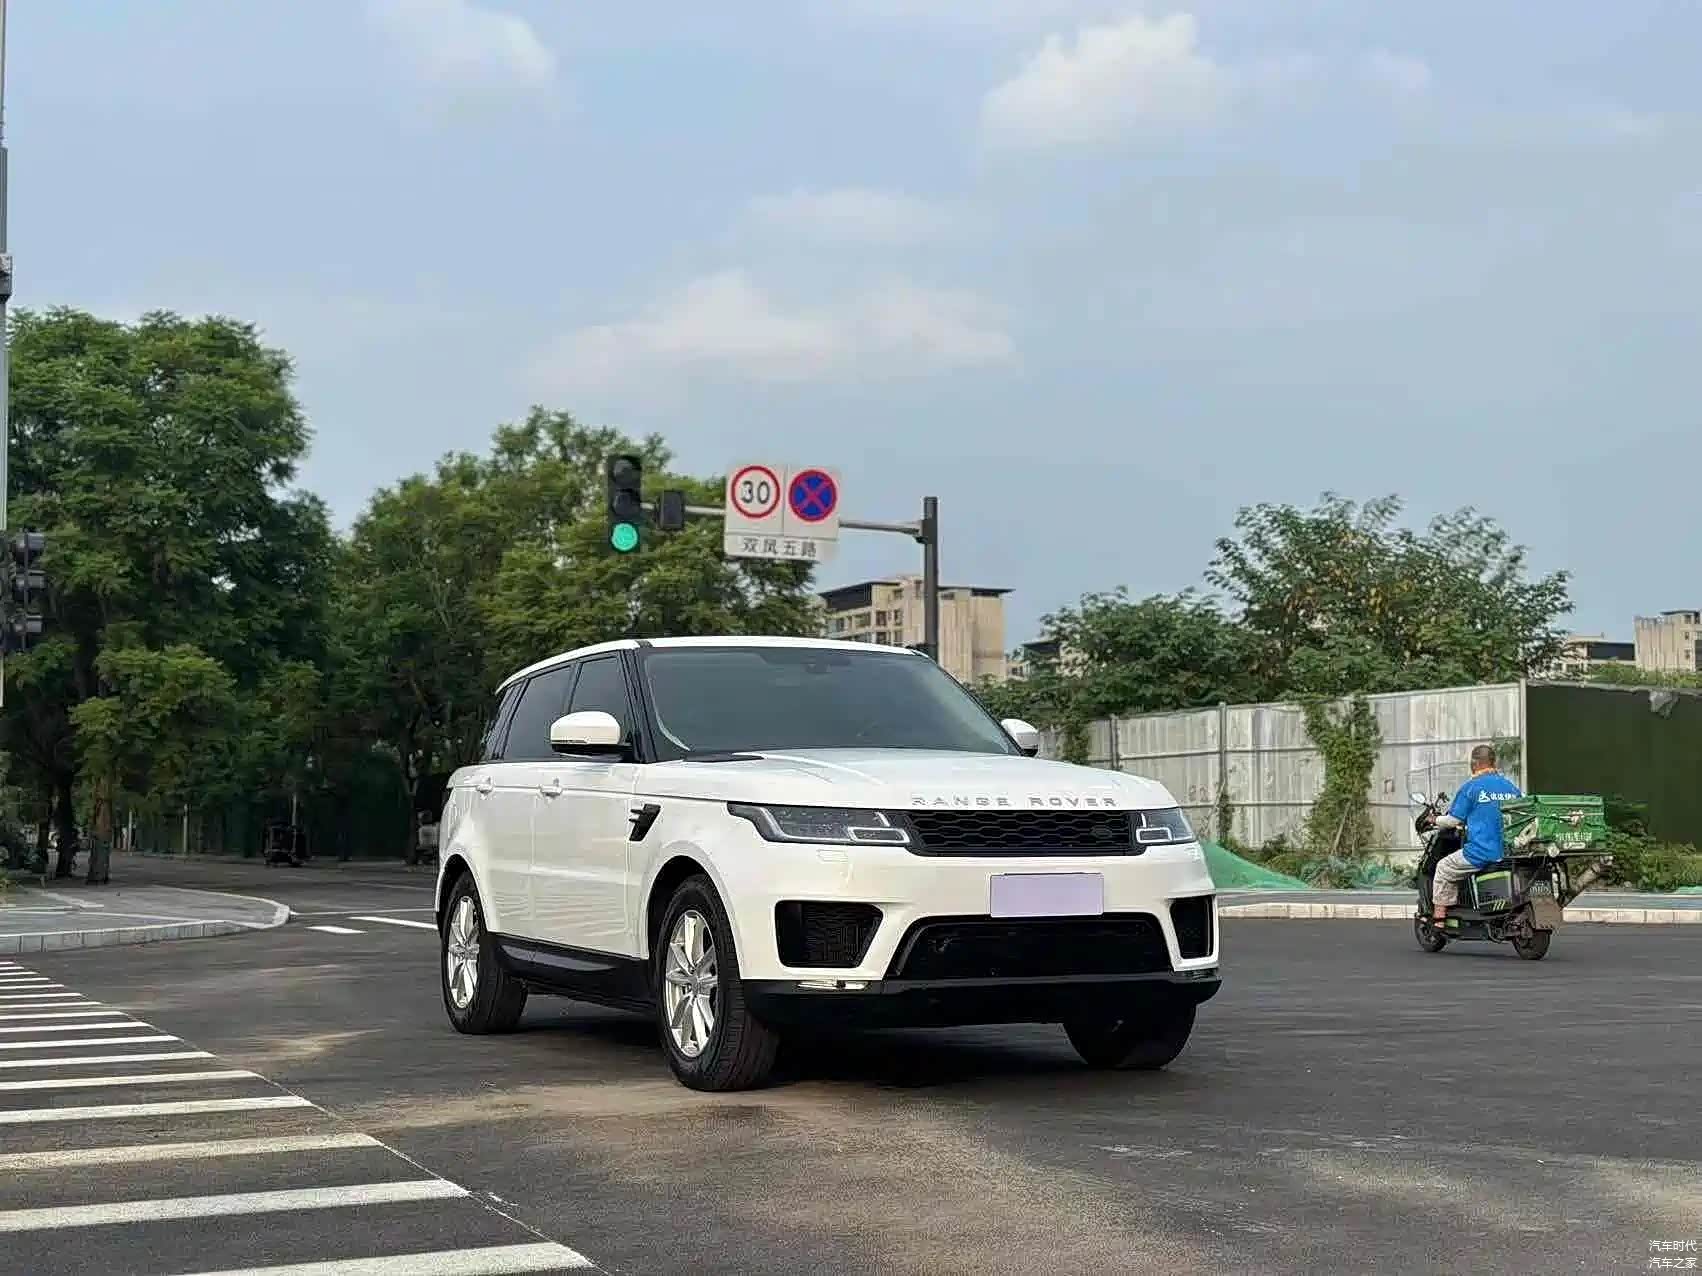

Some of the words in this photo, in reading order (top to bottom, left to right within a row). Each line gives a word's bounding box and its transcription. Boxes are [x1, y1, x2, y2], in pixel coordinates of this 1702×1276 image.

[741, 480, 770, 504] 30
[911, 796, 1011, 807] RANGE
[1028, 796, 1117, 807] ROVER
